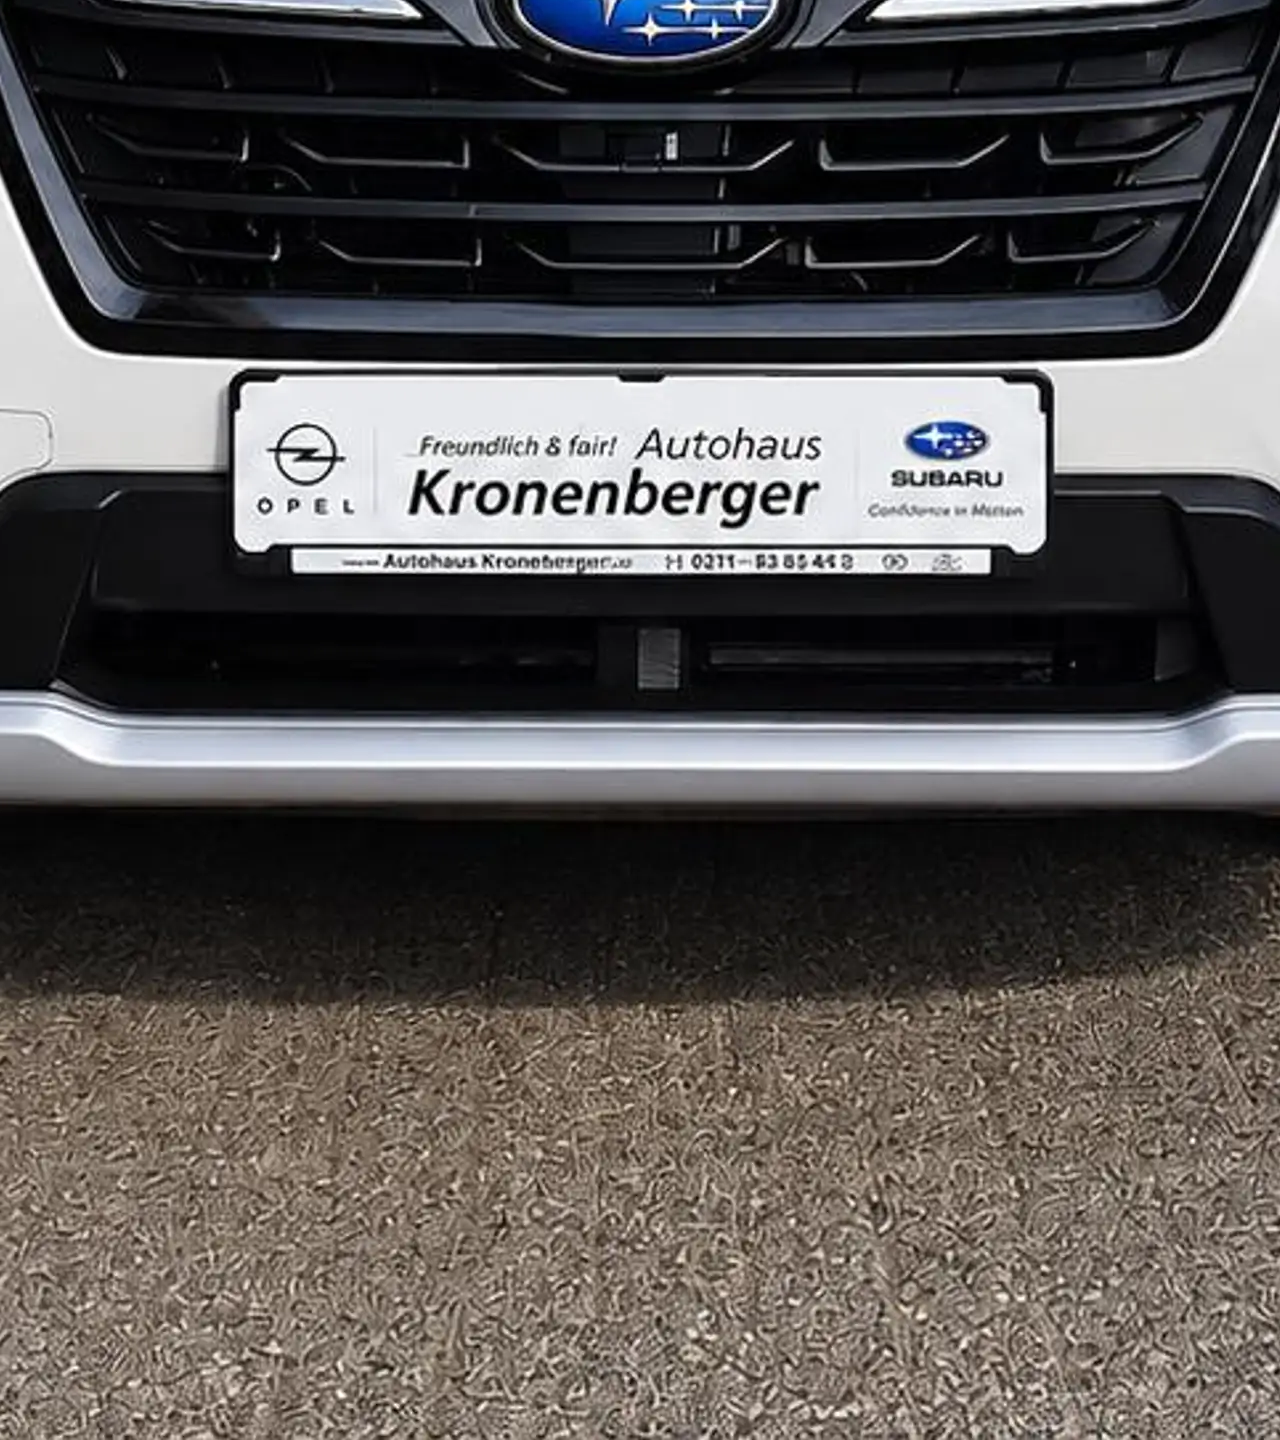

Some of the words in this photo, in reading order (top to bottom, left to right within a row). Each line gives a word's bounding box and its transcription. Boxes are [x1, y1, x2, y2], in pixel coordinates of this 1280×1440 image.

[419, 435, 540, 457] Freundlich
[544, 435, 562, 457] &
[568, 434, 618, 457] fair!
[634, 426, 822, 461] Autohaus
[891, 469, 1003, 488] SUBARU
[256, 496, 355, 515] OPEL
[407, 467, 821, 530] Kronenberger
